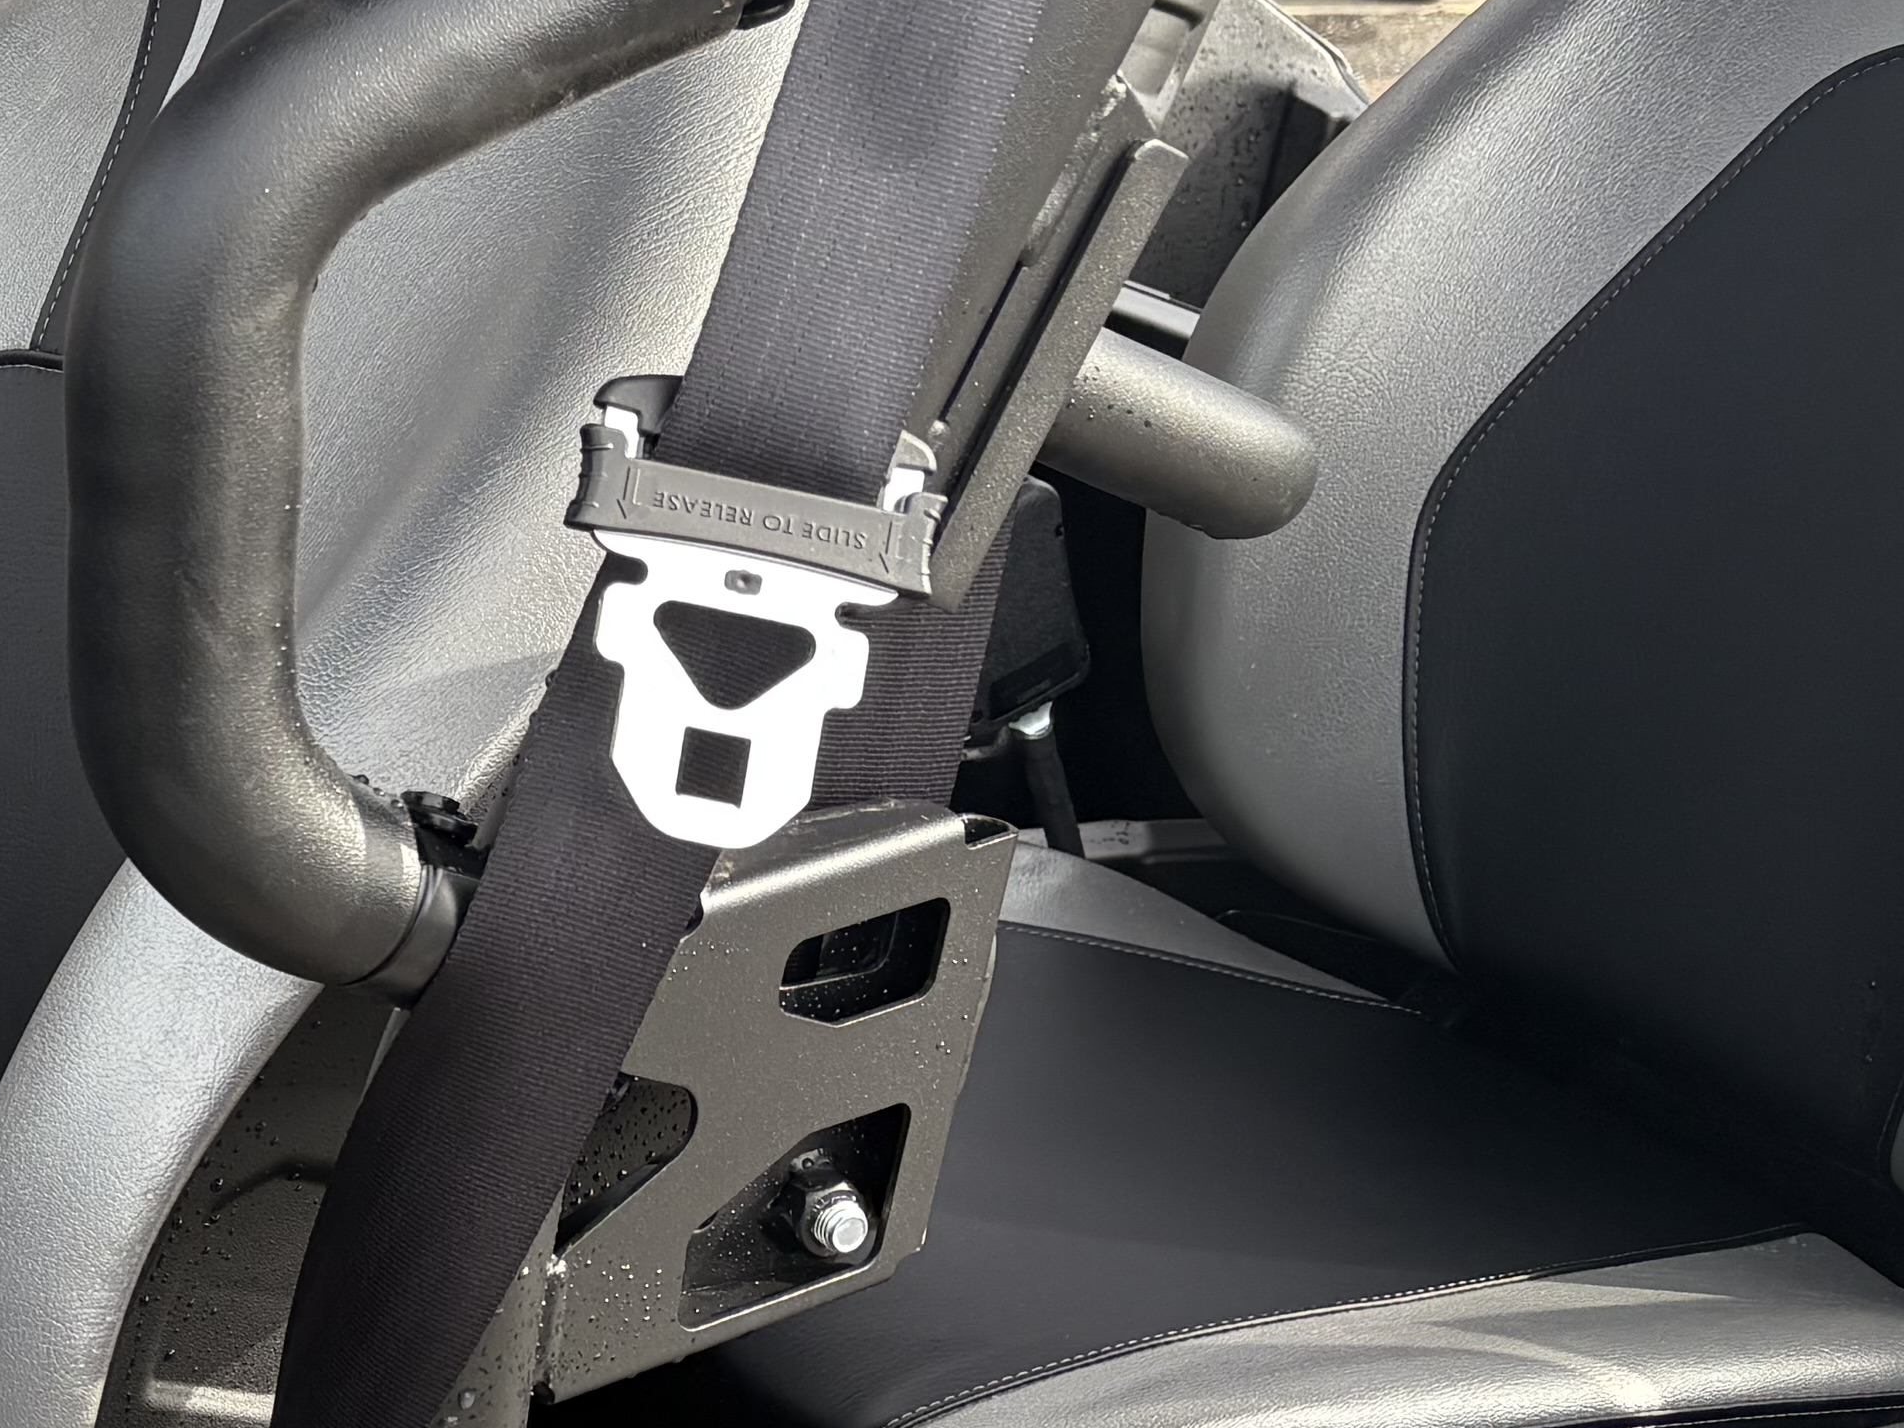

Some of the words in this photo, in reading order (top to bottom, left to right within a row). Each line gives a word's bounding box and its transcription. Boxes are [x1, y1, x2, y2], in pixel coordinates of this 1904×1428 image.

[651, 489, 753, 527] RELEASE
[762, 513, 794, 534] TO
[802, 521, 868, 551] SLIDE
